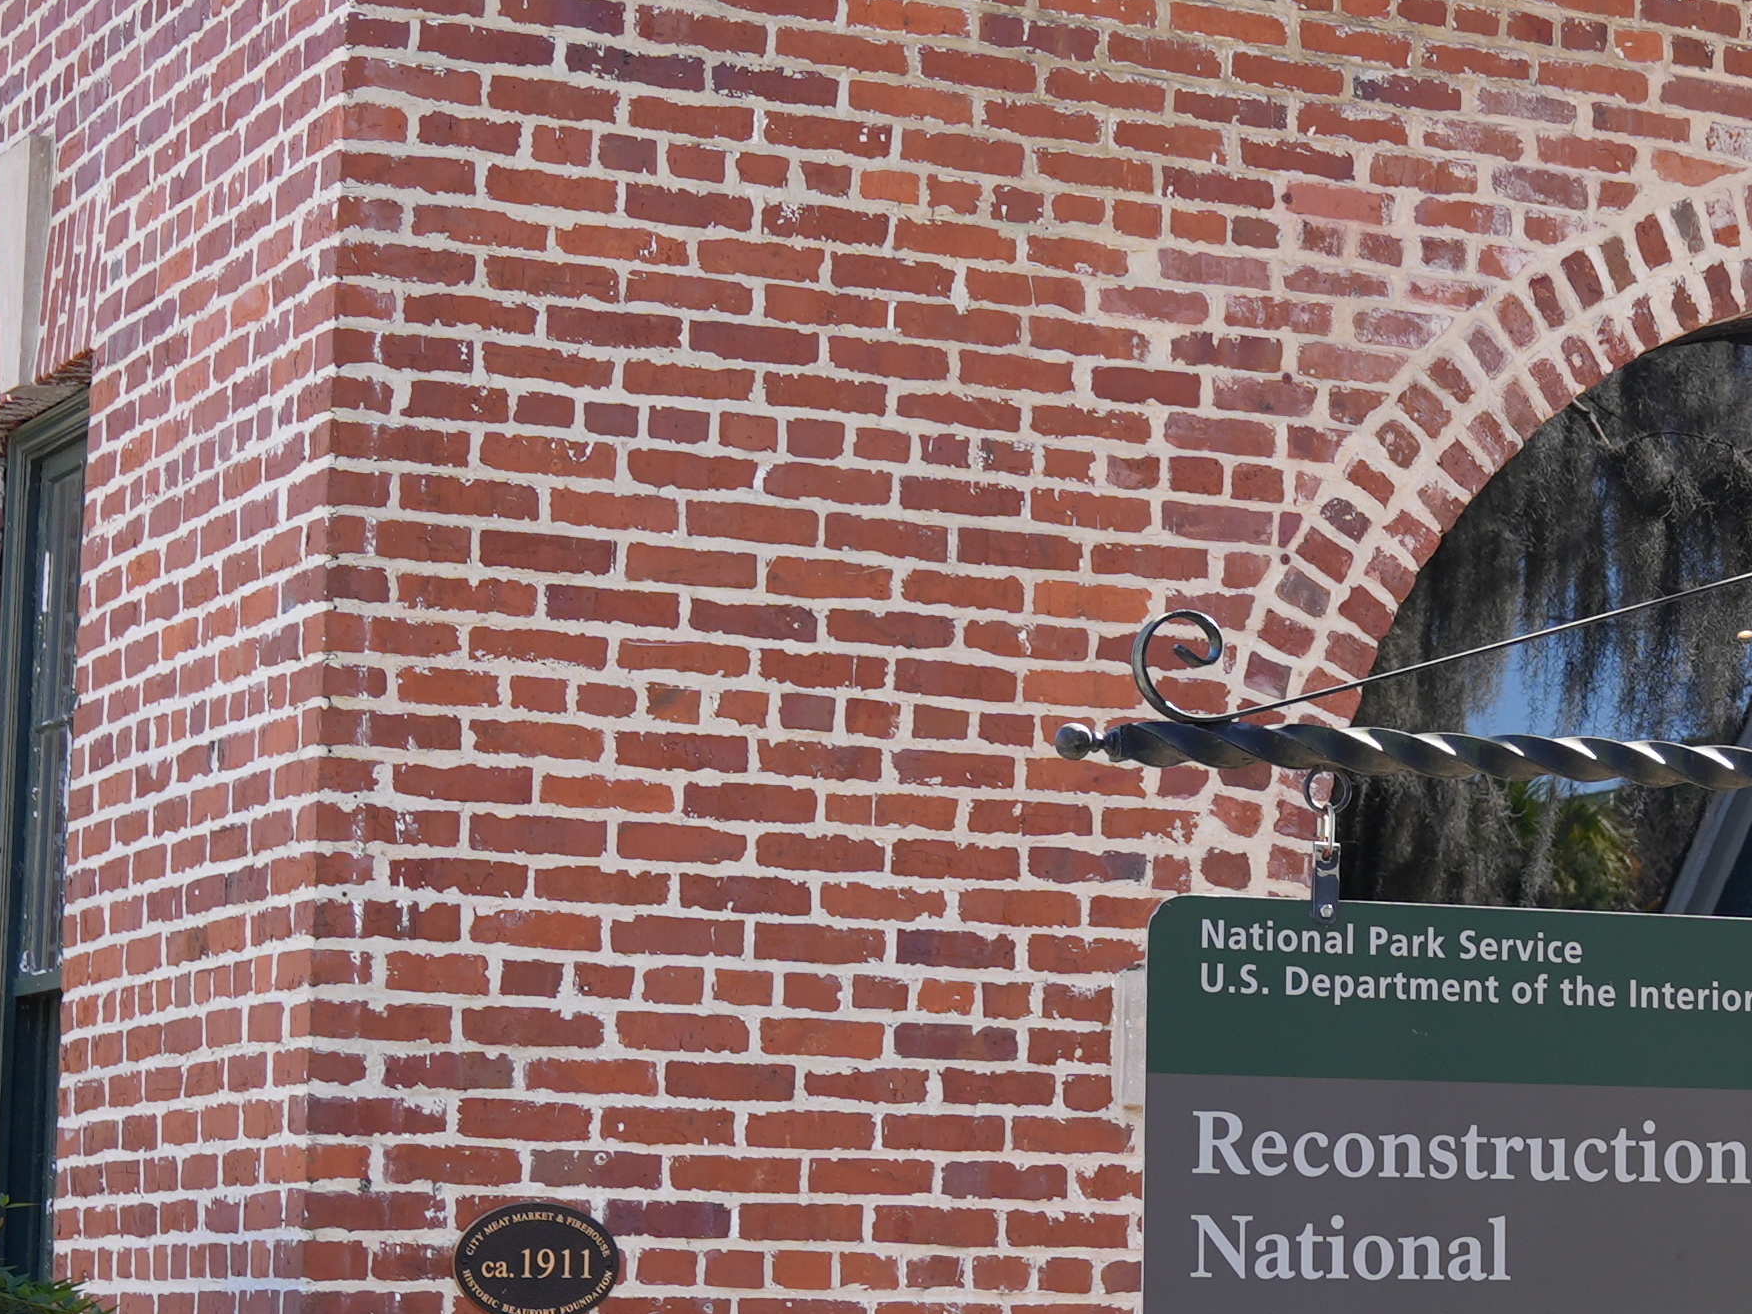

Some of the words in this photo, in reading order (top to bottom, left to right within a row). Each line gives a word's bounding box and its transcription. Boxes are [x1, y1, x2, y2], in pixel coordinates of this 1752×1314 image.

[1199, 918, 1355, 957] National
[1368, 926, 1445, 960] Park
[1459, 929, 1583, 964] Service
[1199, 963, 1270, 997] U.S.
[1284, 967, 1499, 1006] Department
[1511, 973, 1548, 1005] of
[1560, 976, 1616, 1009] the
[1192, 1110, 1751, 1186] Reconstruction
[466, 1232, 484, 1256] CITY
[483, 1216, 510, 1235] MEAT
[512, 1212, 554, 1223] MARKET
[556, 1214, 564, 1223] &
[566, 1216, 611, 1257] FIREHOUSE
[1190, 1215, 1511, 1282] National
[481, 1260, 515, 1278] ca.
[521, 1248, 592, 1279] 1911
[462, 1270, 499, 1308] HISTORIC
[560, 1270, 613, 1314] FOUNDATION
